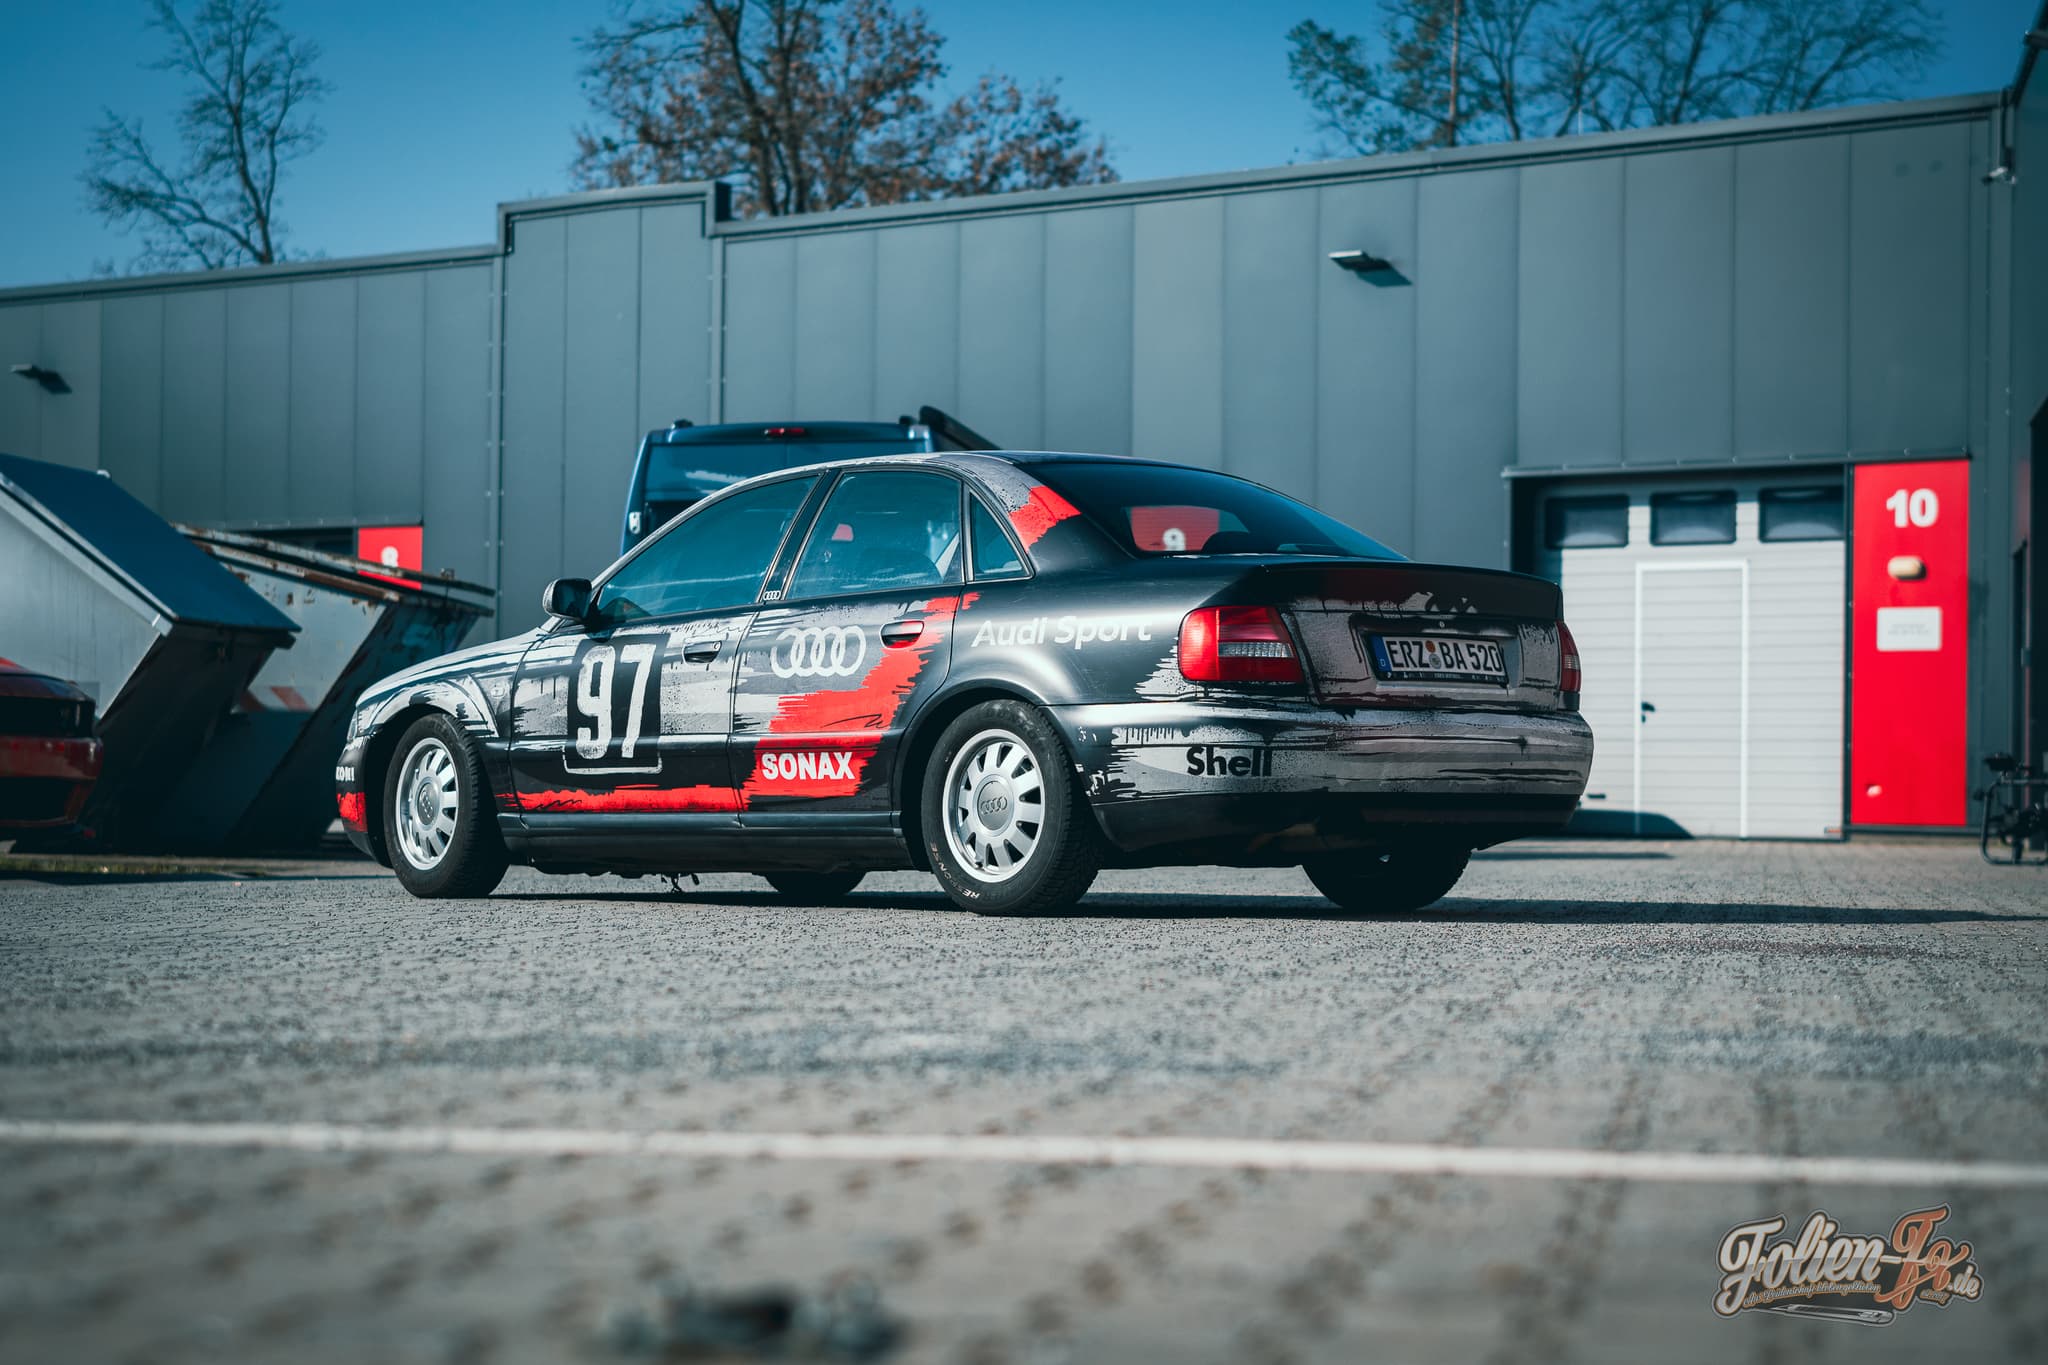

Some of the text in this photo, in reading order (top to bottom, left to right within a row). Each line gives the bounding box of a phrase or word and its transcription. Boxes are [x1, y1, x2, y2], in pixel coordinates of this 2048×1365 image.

[1886, 489, 1938, 527] 10
[970, 614, 1152, 650] Audi Sport
[1386, 640, 1430, 669] ERZ
[1439, 642, 1468, 670] BA
[1468, 644, 1503, 672] 520
[576, 643, 657, 760] 97
[761, 752, 855, 781] SONAX
[1188, 746, 1273, 778] Shell
[930, 841, 981, 899] REONSE
